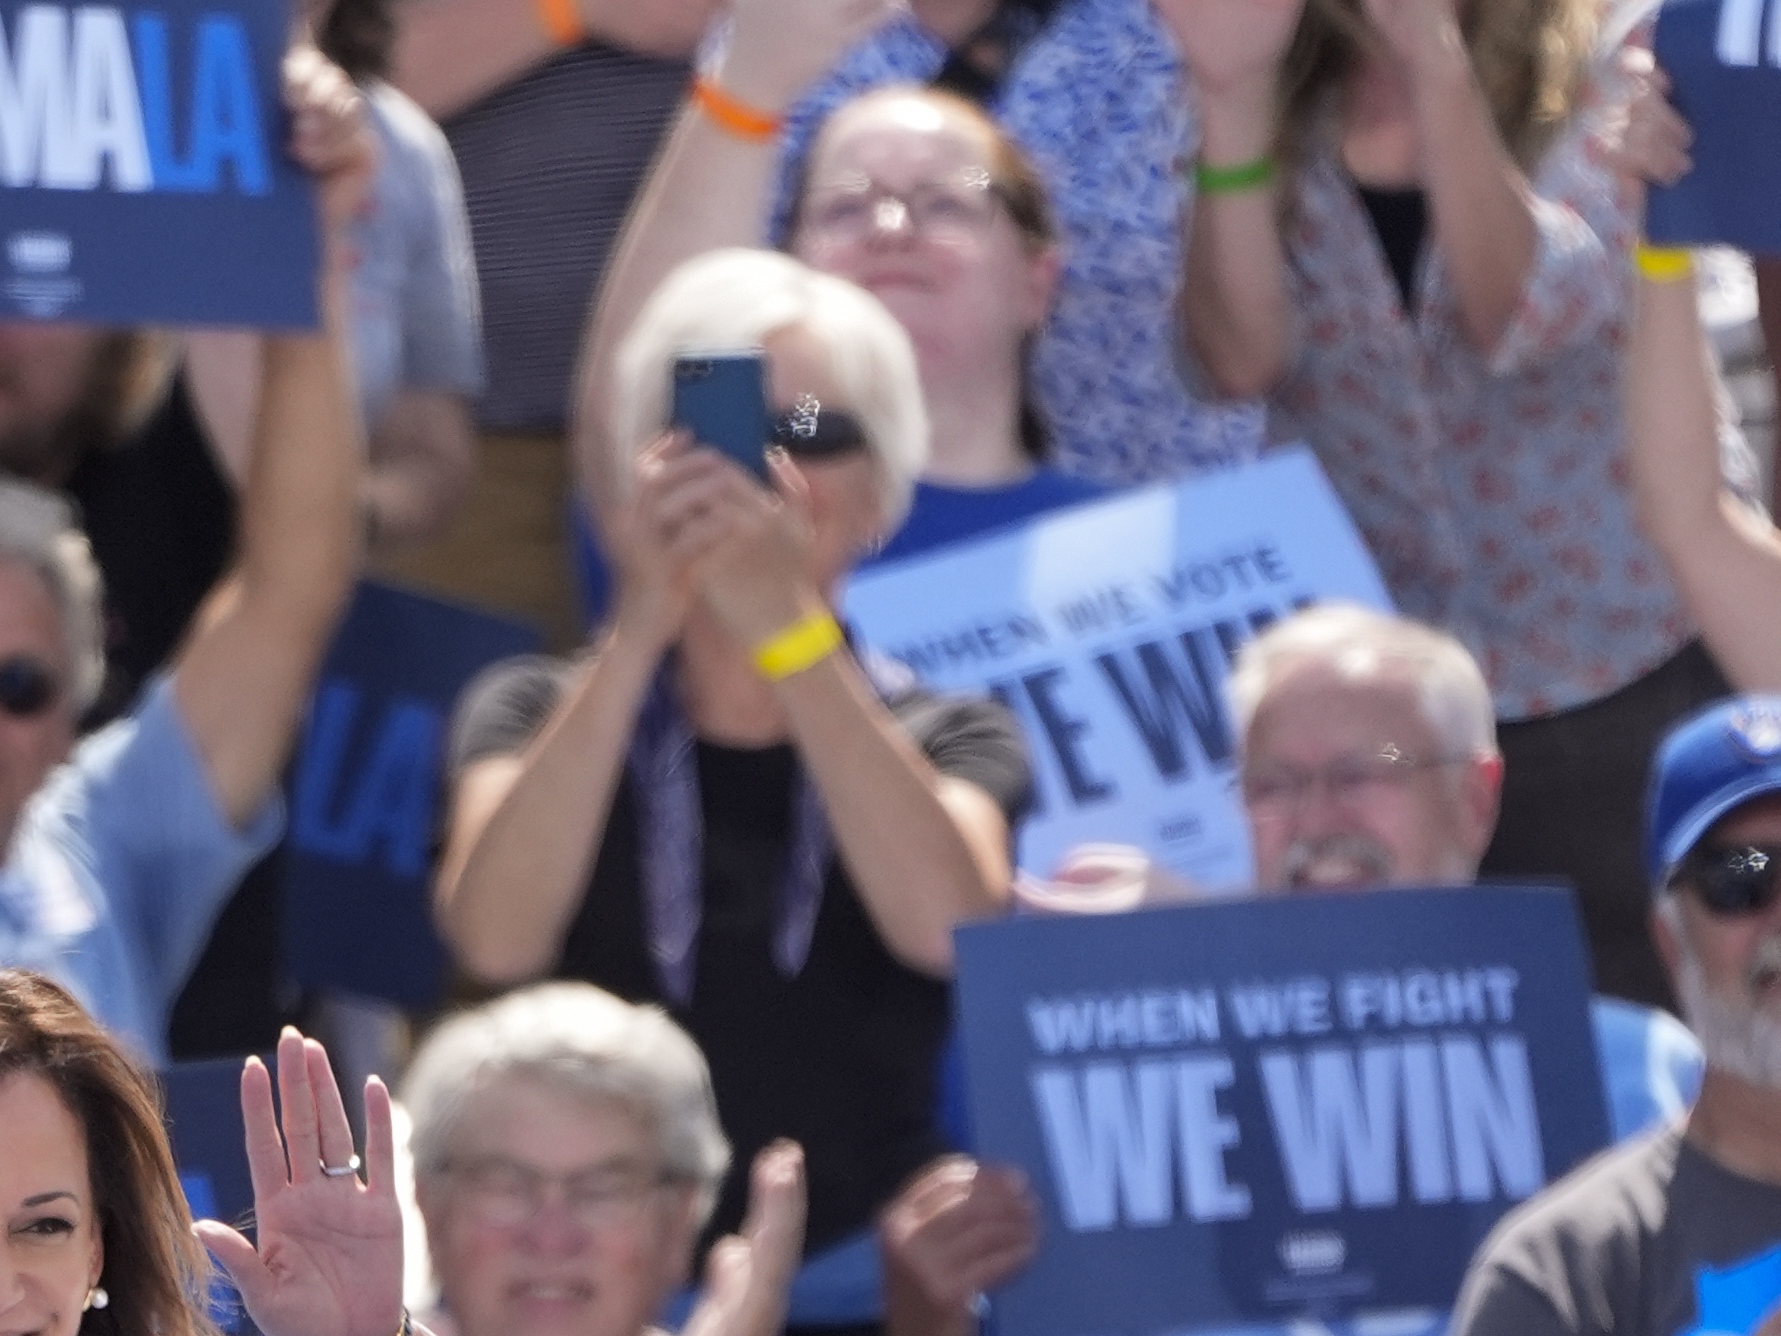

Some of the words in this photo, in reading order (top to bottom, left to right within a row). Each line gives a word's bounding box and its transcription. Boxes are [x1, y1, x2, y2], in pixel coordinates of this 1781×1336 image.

[1156, 544, 1294, 602] VOTE
[1030, 988, 1220, 1054] WHEN
[1229, 978, 1333, 1036] WE
[1338, 967, 1520, 1030] FIGHT
[1032, 1052, 1253, 1230] WE
[1259, 1034, 1547, 1213] WIN
